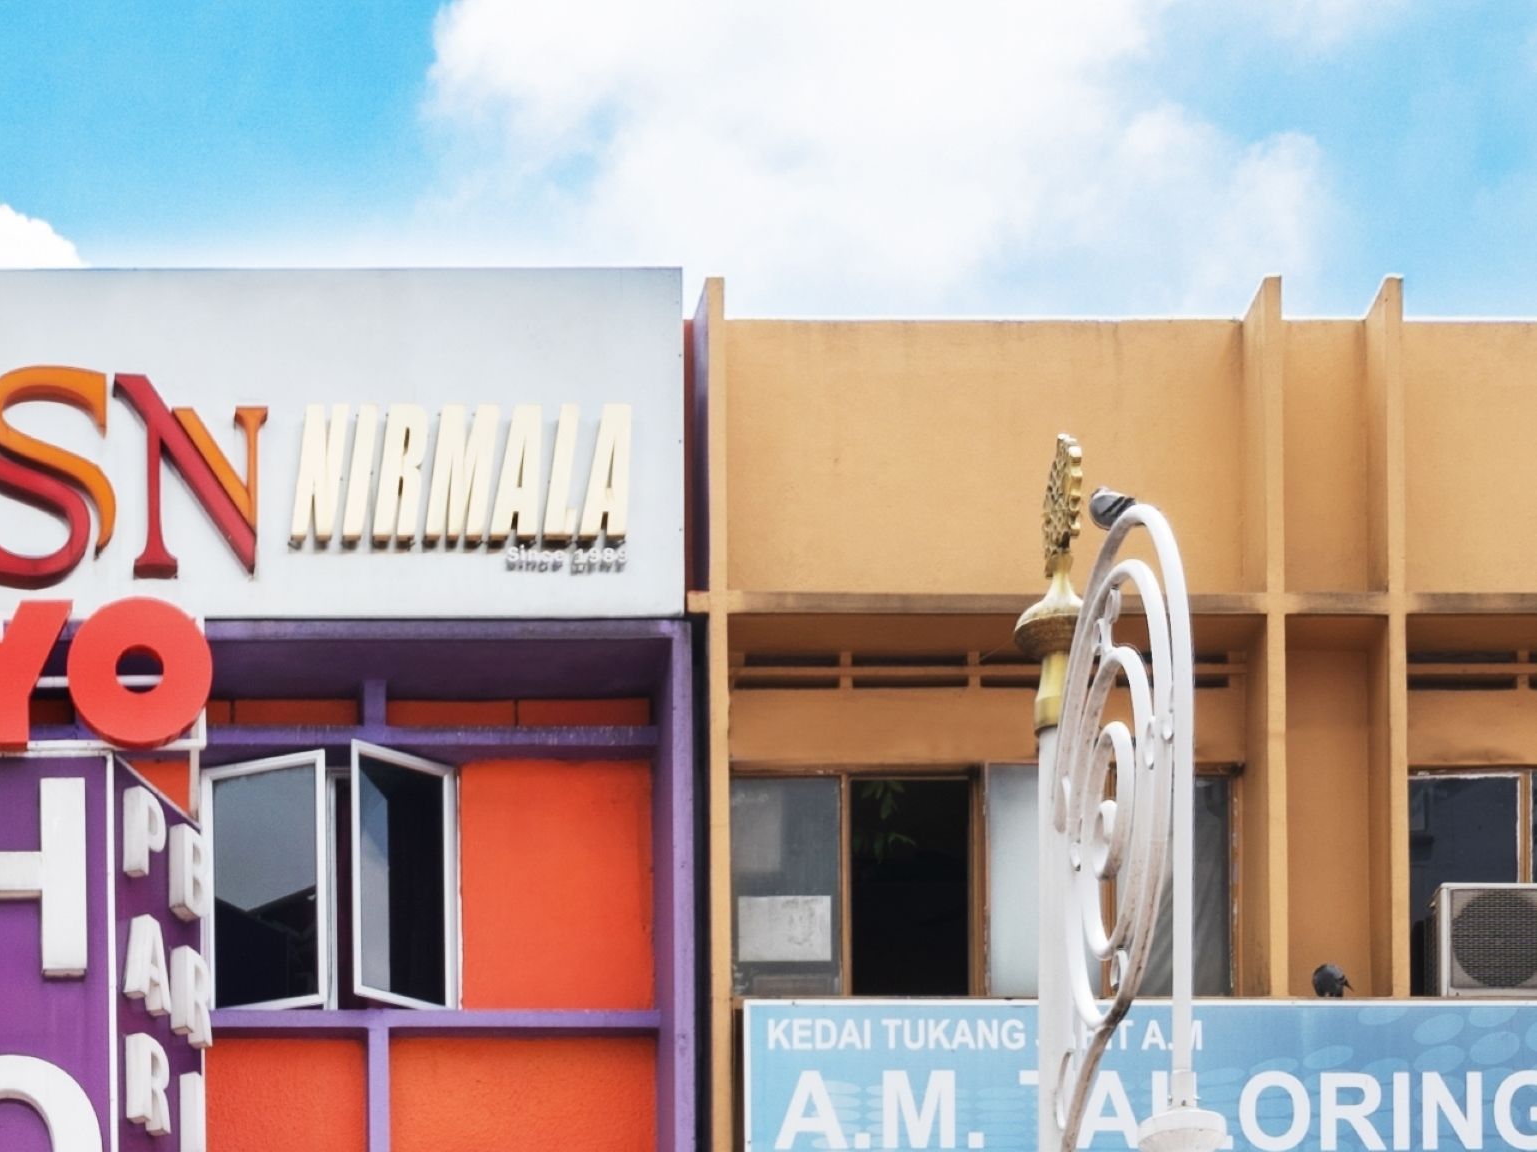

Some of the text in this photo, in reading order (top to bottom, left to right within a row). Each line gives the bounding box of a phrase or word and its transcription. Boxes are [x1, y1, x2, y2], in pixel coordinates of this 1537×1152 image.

[288, 404, 632, 547] NIRMALA
[505, 545, 564, 566] Since
[767, 1018, 871, 1050] KEDAI
[881, 1018, 1026, 1050] TUKANG
[774, 1070, 985, 1150] A.M.
